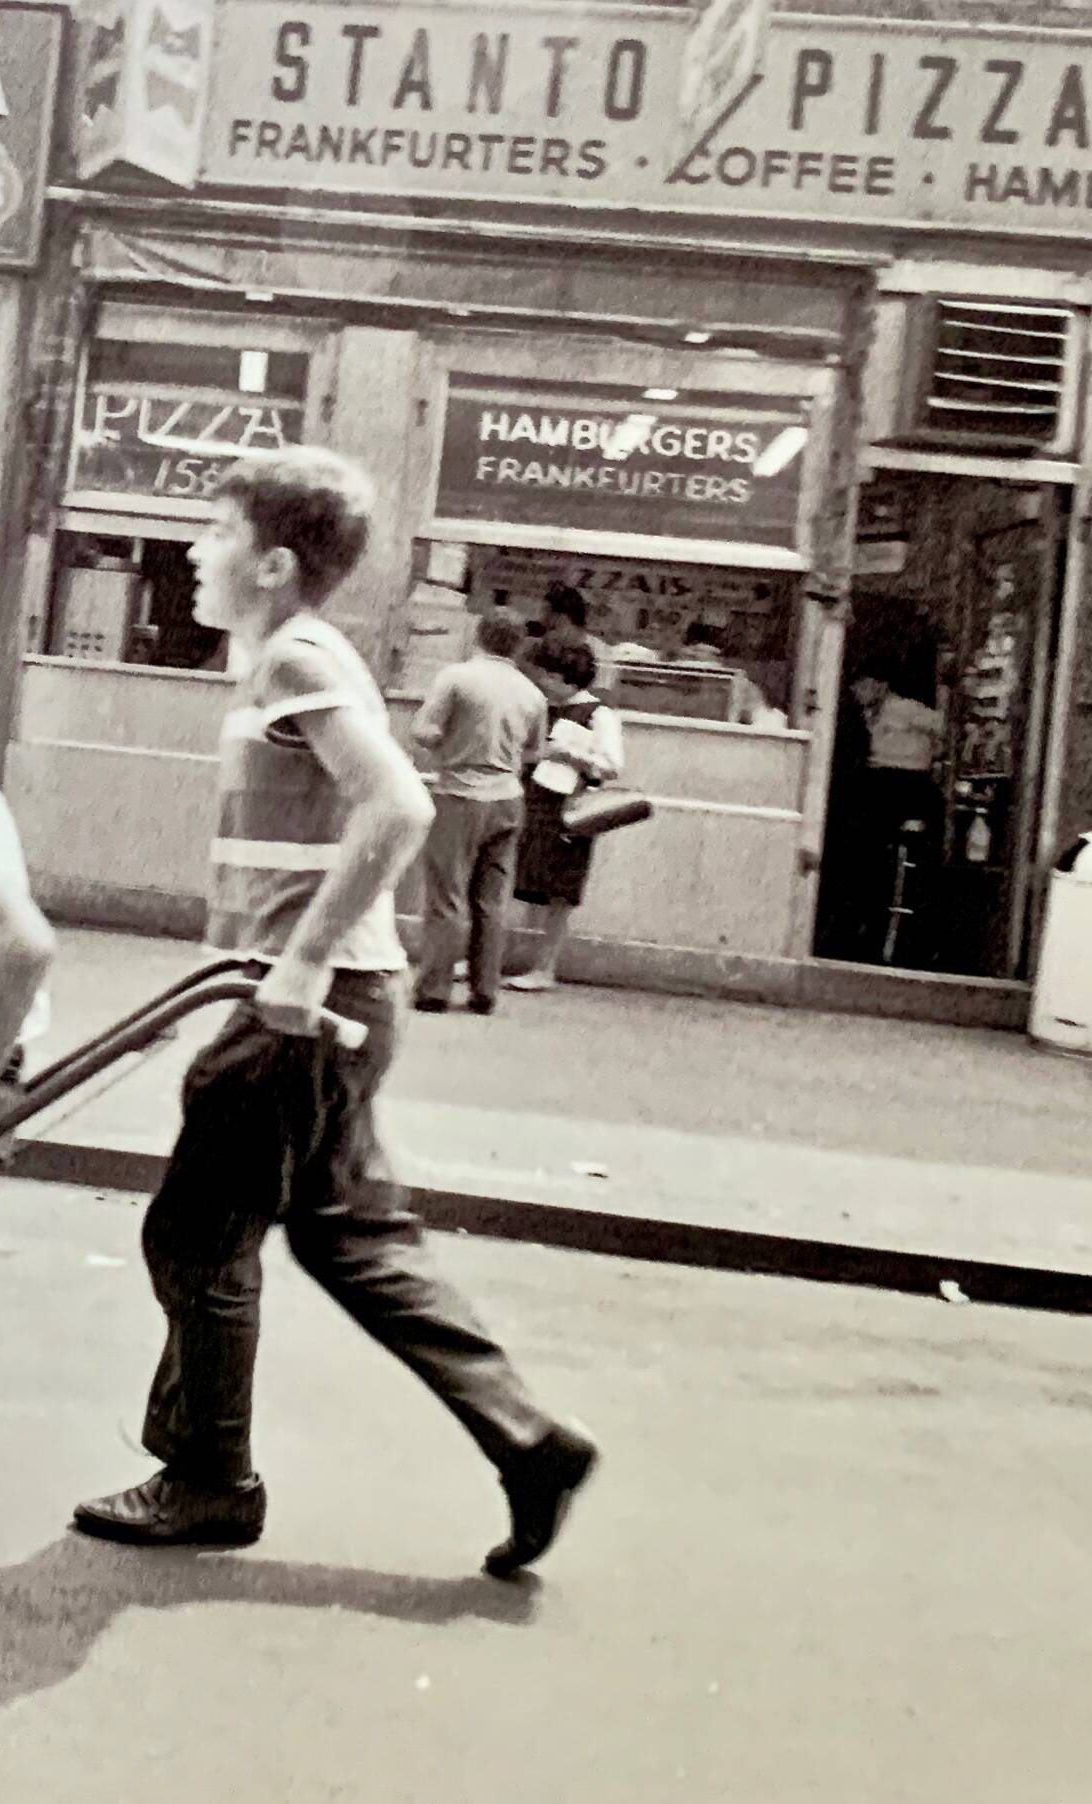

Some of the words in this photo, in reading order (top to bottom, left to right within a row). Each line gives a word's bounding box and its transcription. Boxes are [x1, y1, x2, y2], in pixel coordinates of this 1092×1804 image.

[789, 48, 1091, 149] PIZZA
[229, 119, 609, 180] FRANKFURTERS
[674, 146, 895, 196] COFFEE
[964, 162, 1092, 208] HAM
[95, 395, 286, 449] PIZZA
[475, 456, 755, 503] FRANKFURTERS
